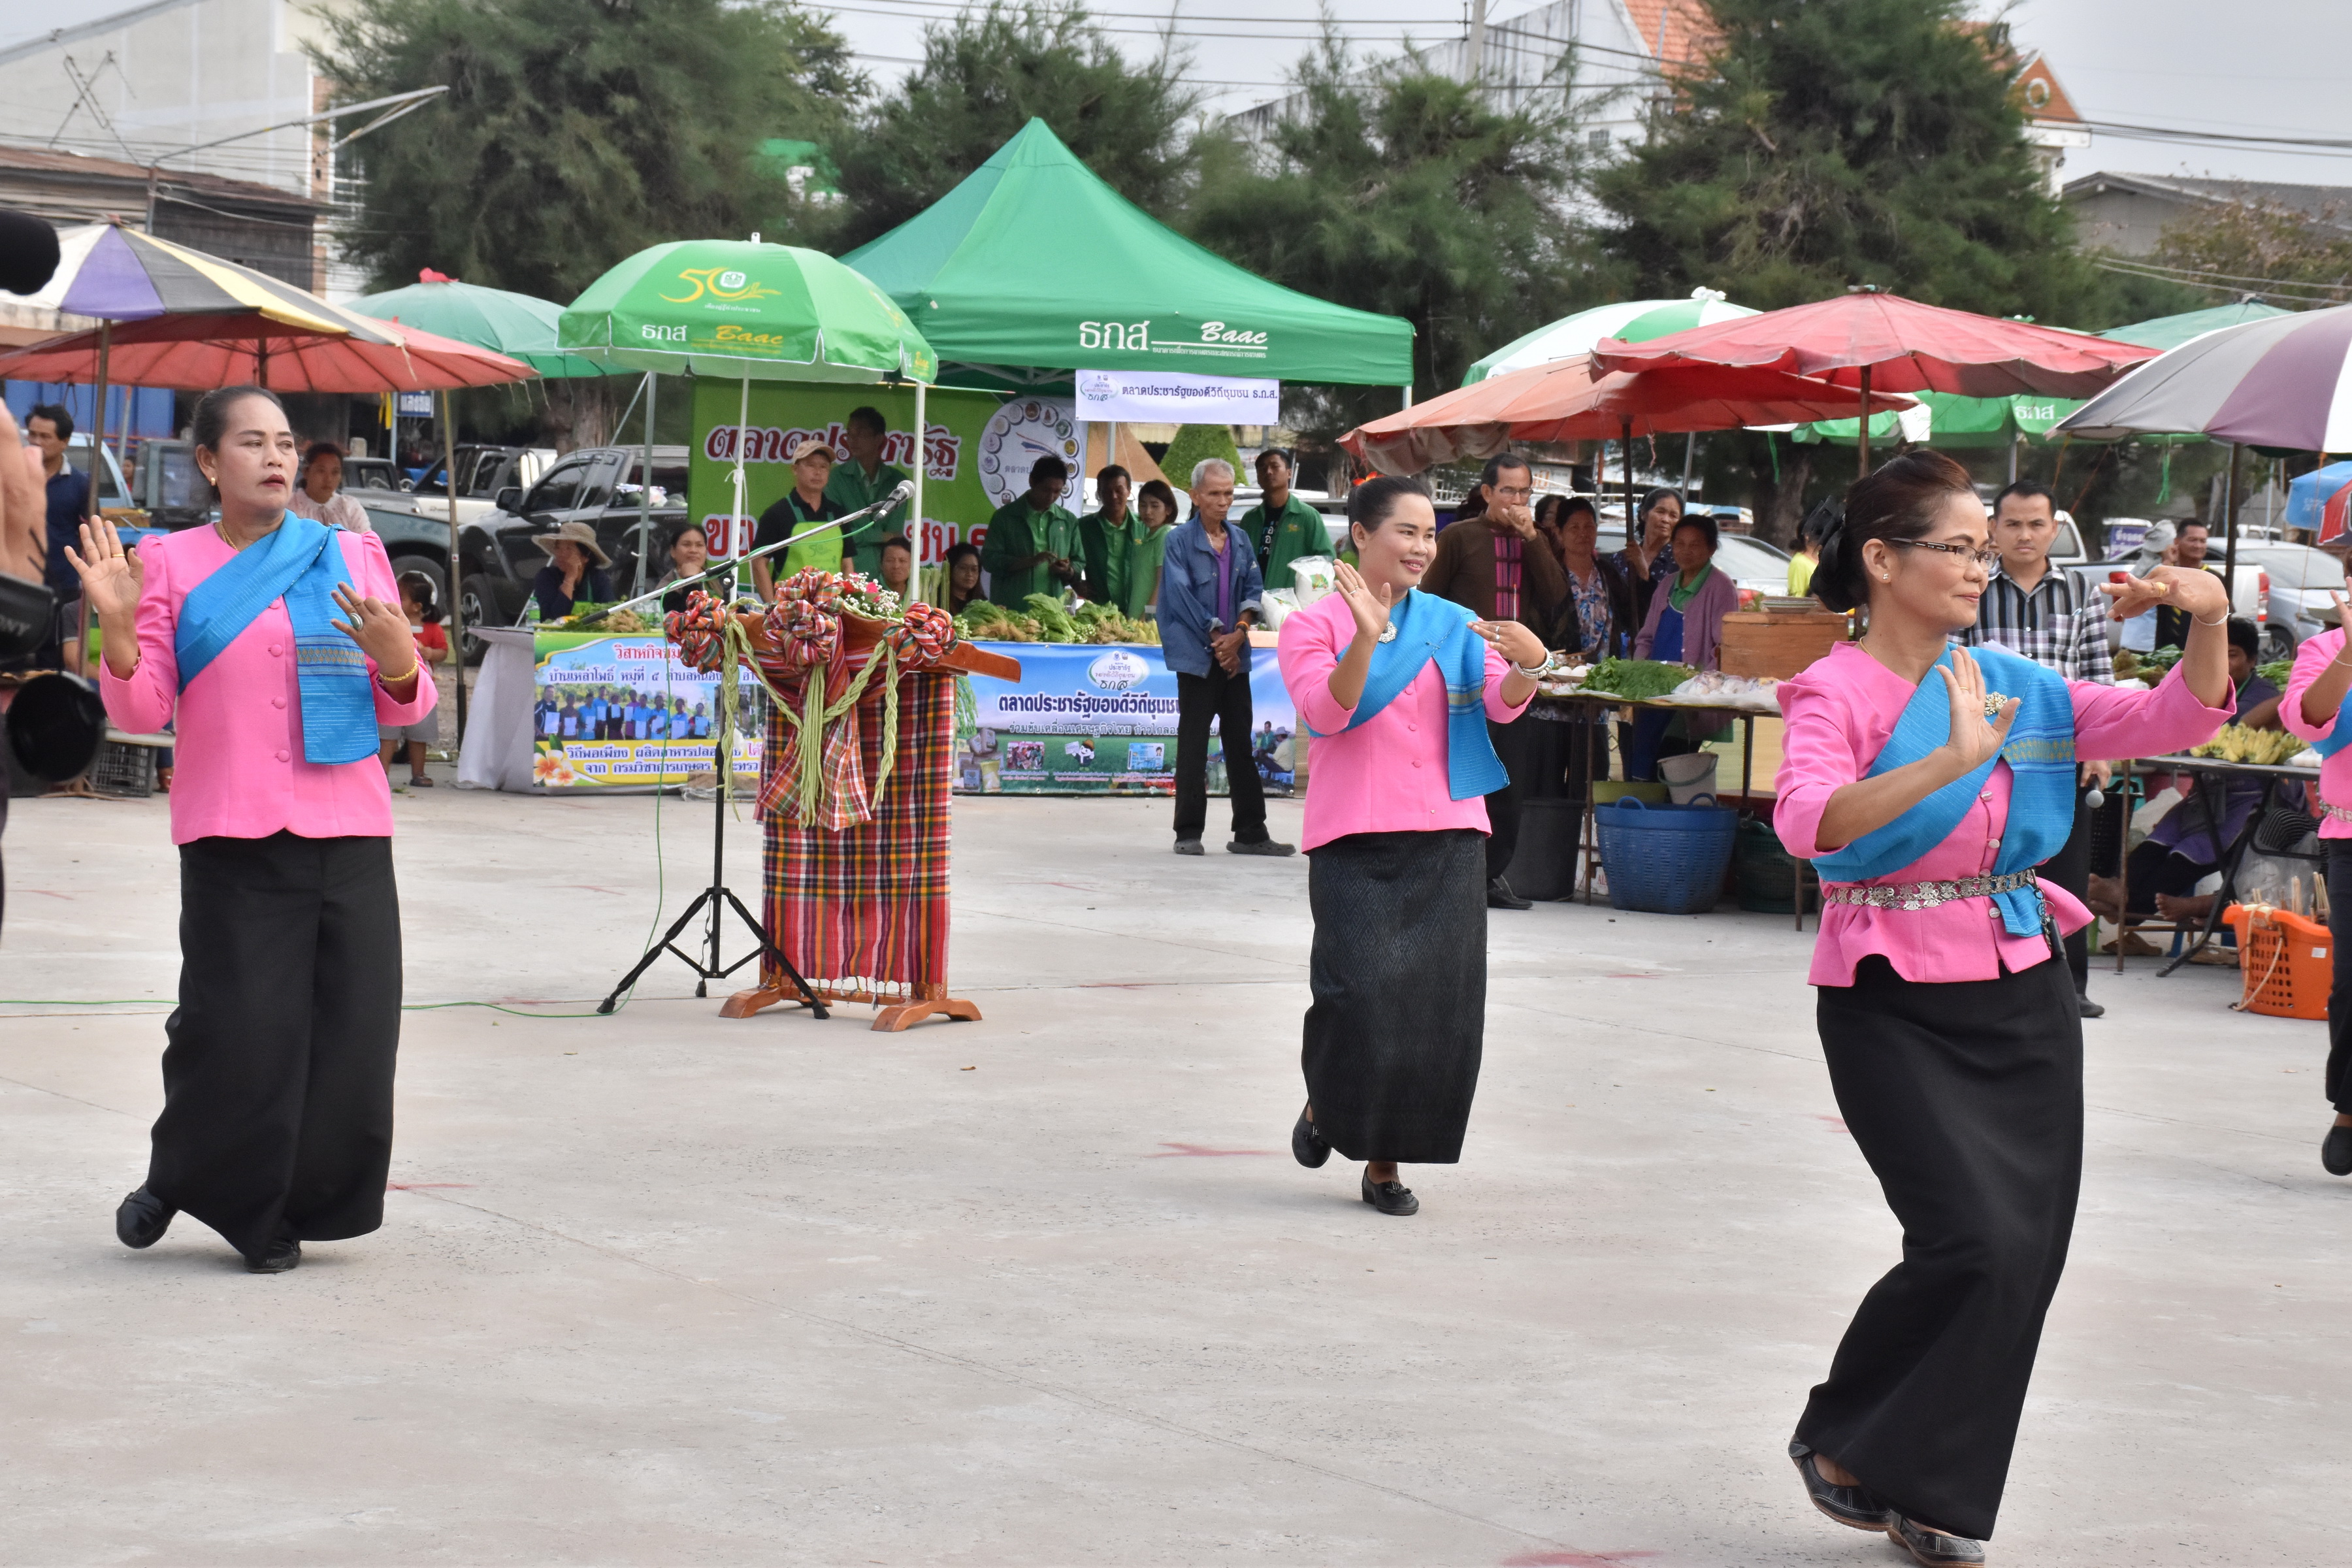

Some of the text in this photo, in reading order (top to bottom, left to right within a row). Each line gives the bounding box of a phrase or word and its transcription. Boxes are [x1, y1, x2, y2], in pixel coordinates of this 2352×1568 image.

[642, 323, 783, 344] ธกส Baac
[1079, 320, 1268, 351] ธกส Baac
[1122, 385, 1249, 400] ตลาดประชารัฐของดีวิถีชุมชน
[1252, 389, 1278, 399] ธ.ก.ส.
[2015, 405, 2055, 420] ธกส
[614, 644, 681, 664] วิสาหกิจชุม
[549, 666, 615, 682] บ้านเหล่าโพธิ์
[621, 666, 644, 685] หมู่ที่
[651, 672, 659, 681] ๕
[585, 764, 606, 773] จาก
